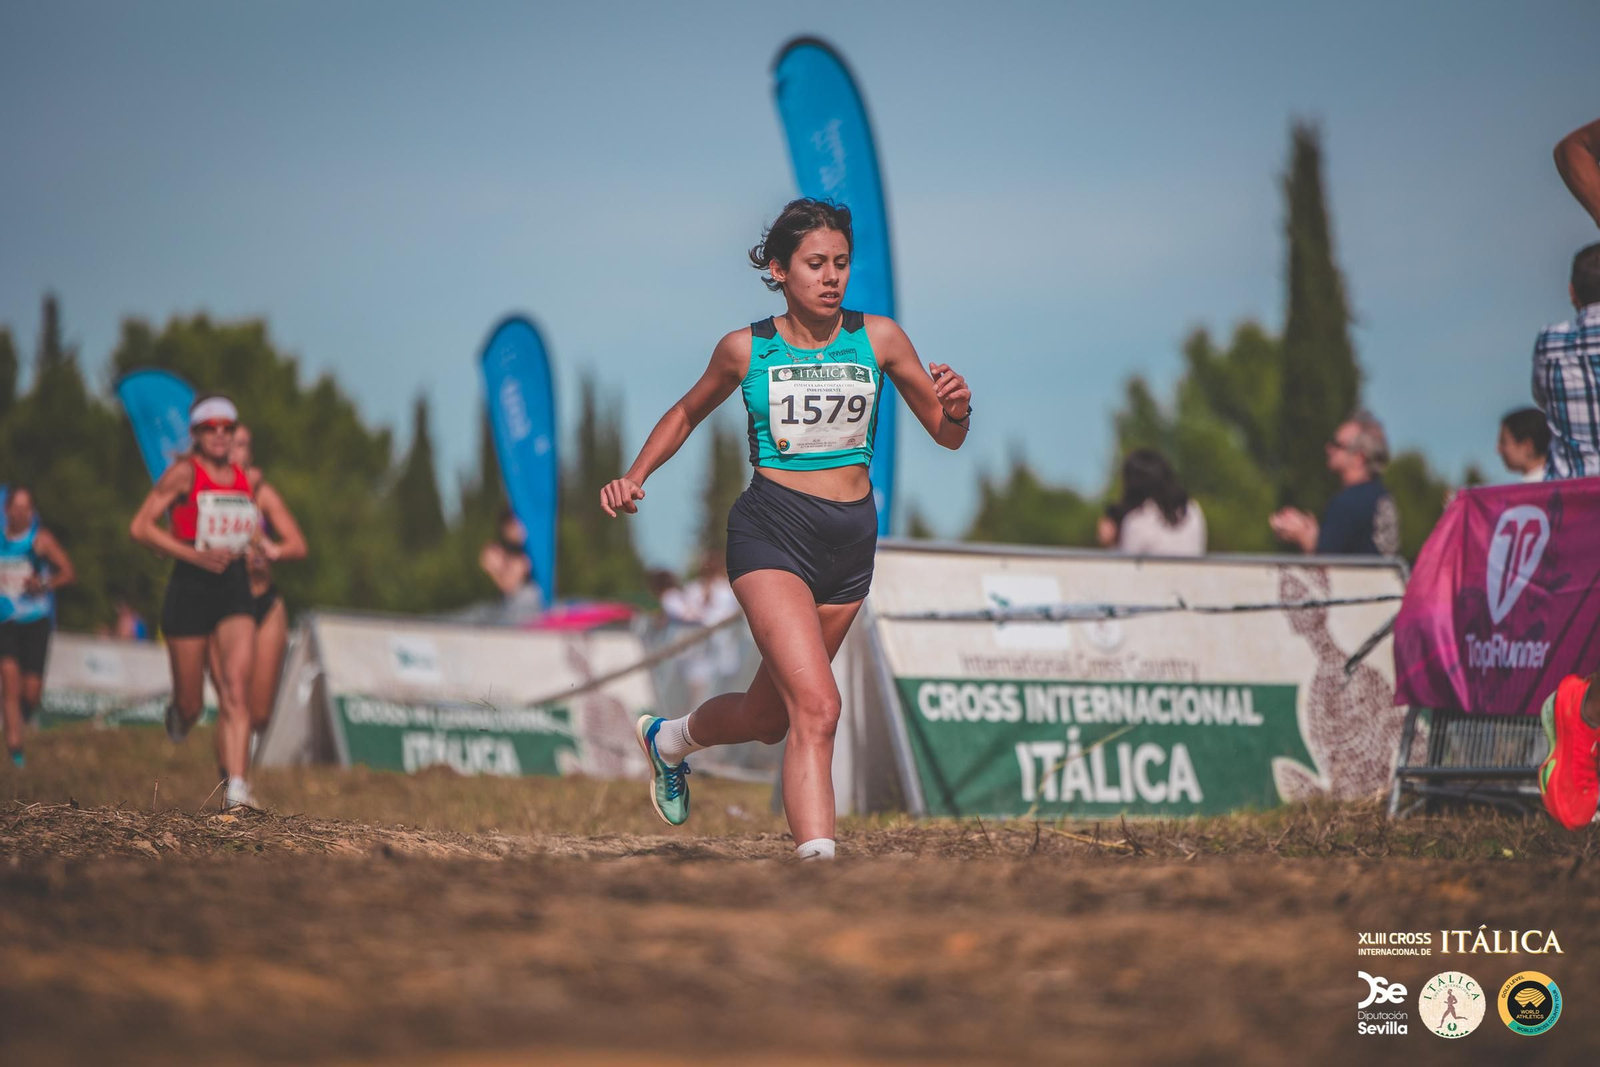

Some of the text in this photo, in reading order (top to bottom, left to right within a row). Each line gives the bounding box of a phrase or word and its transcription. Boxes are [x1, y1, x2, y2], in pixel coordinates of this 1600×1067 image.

[781, 394, 867, 425] 1579
[960, 653, 1072, 676] International
[1466, 633, 1551, 675] TopRunner
[918, 683, 1263, 727] CROSS INTERNACIONAL
[1015, 726, 1203, 804] ITÁLICA
